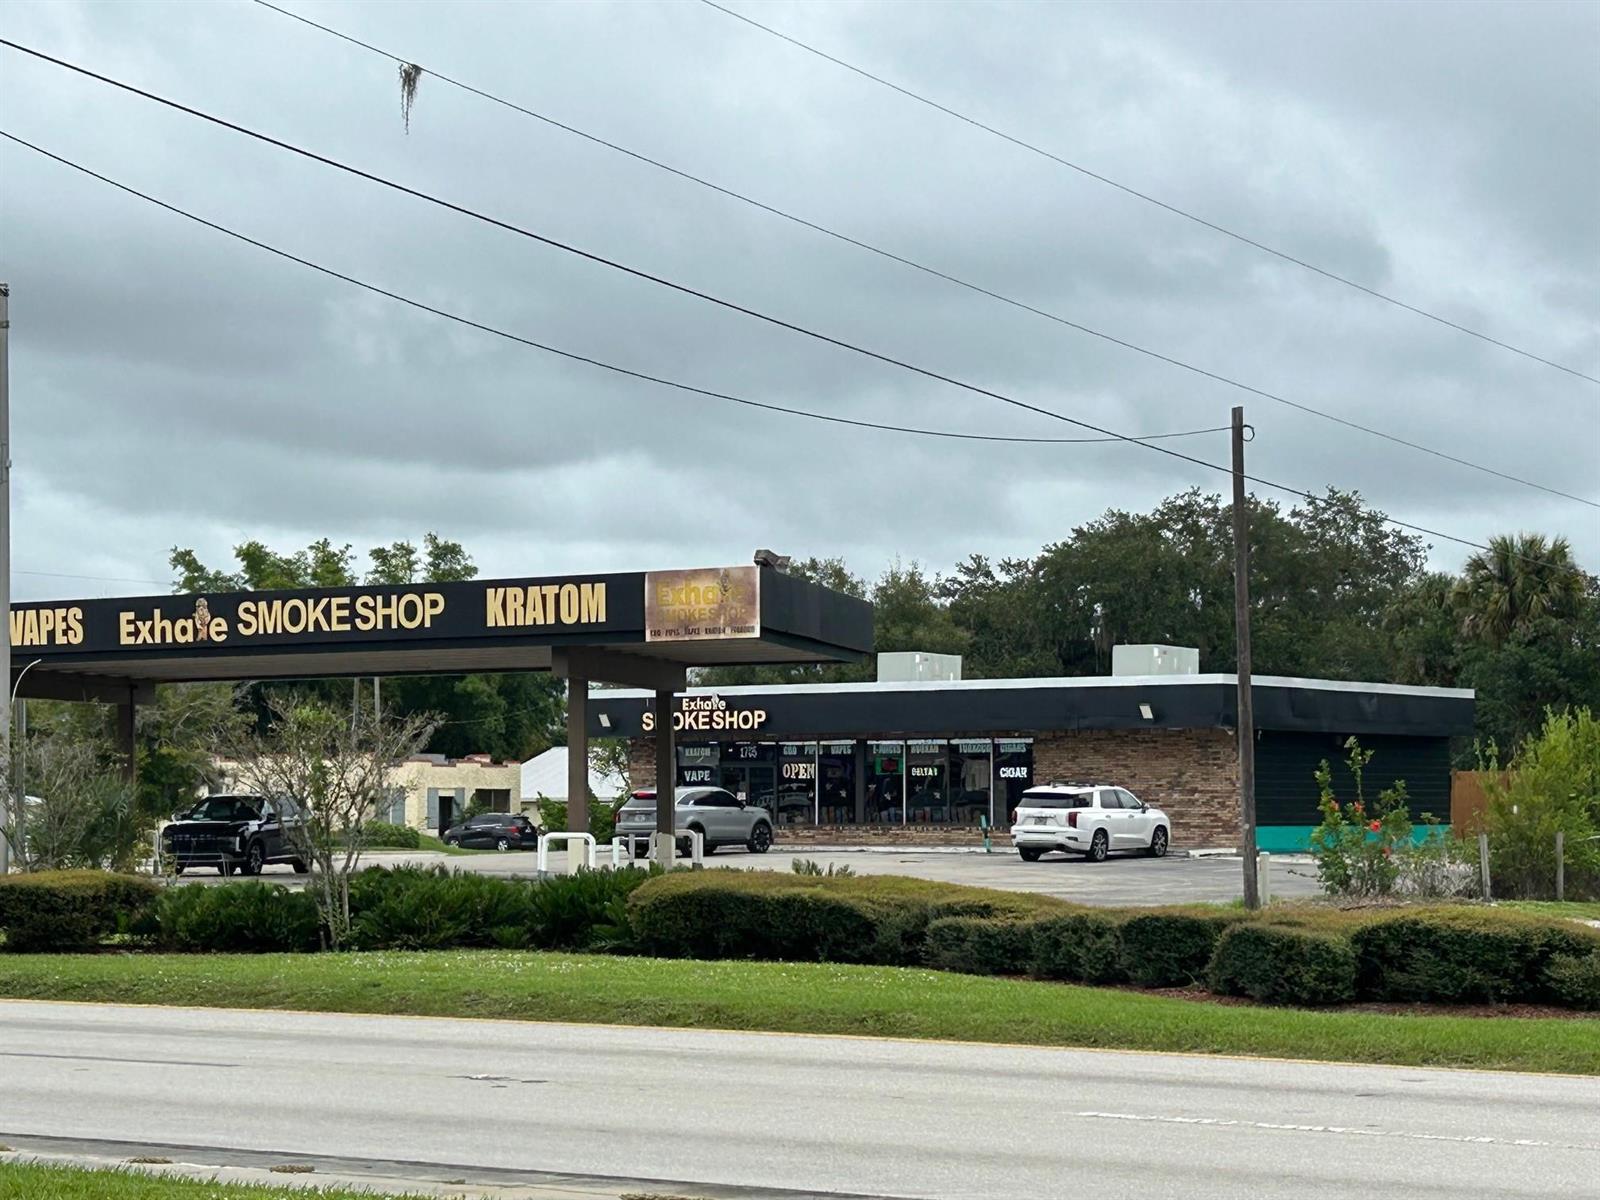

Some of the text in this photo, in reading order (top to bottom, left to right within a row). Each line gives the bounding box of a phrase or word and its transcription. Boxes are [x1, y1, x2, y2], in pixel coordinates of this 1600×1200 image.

[486, 583, 606, 627] KRATOM
[9, 607, 84, 646] VAPES
[684, 770, 710, 782] VAPE
[782, 763, 815, 779] OPEN
[1000, 766, 1027, 778] CIGAR
